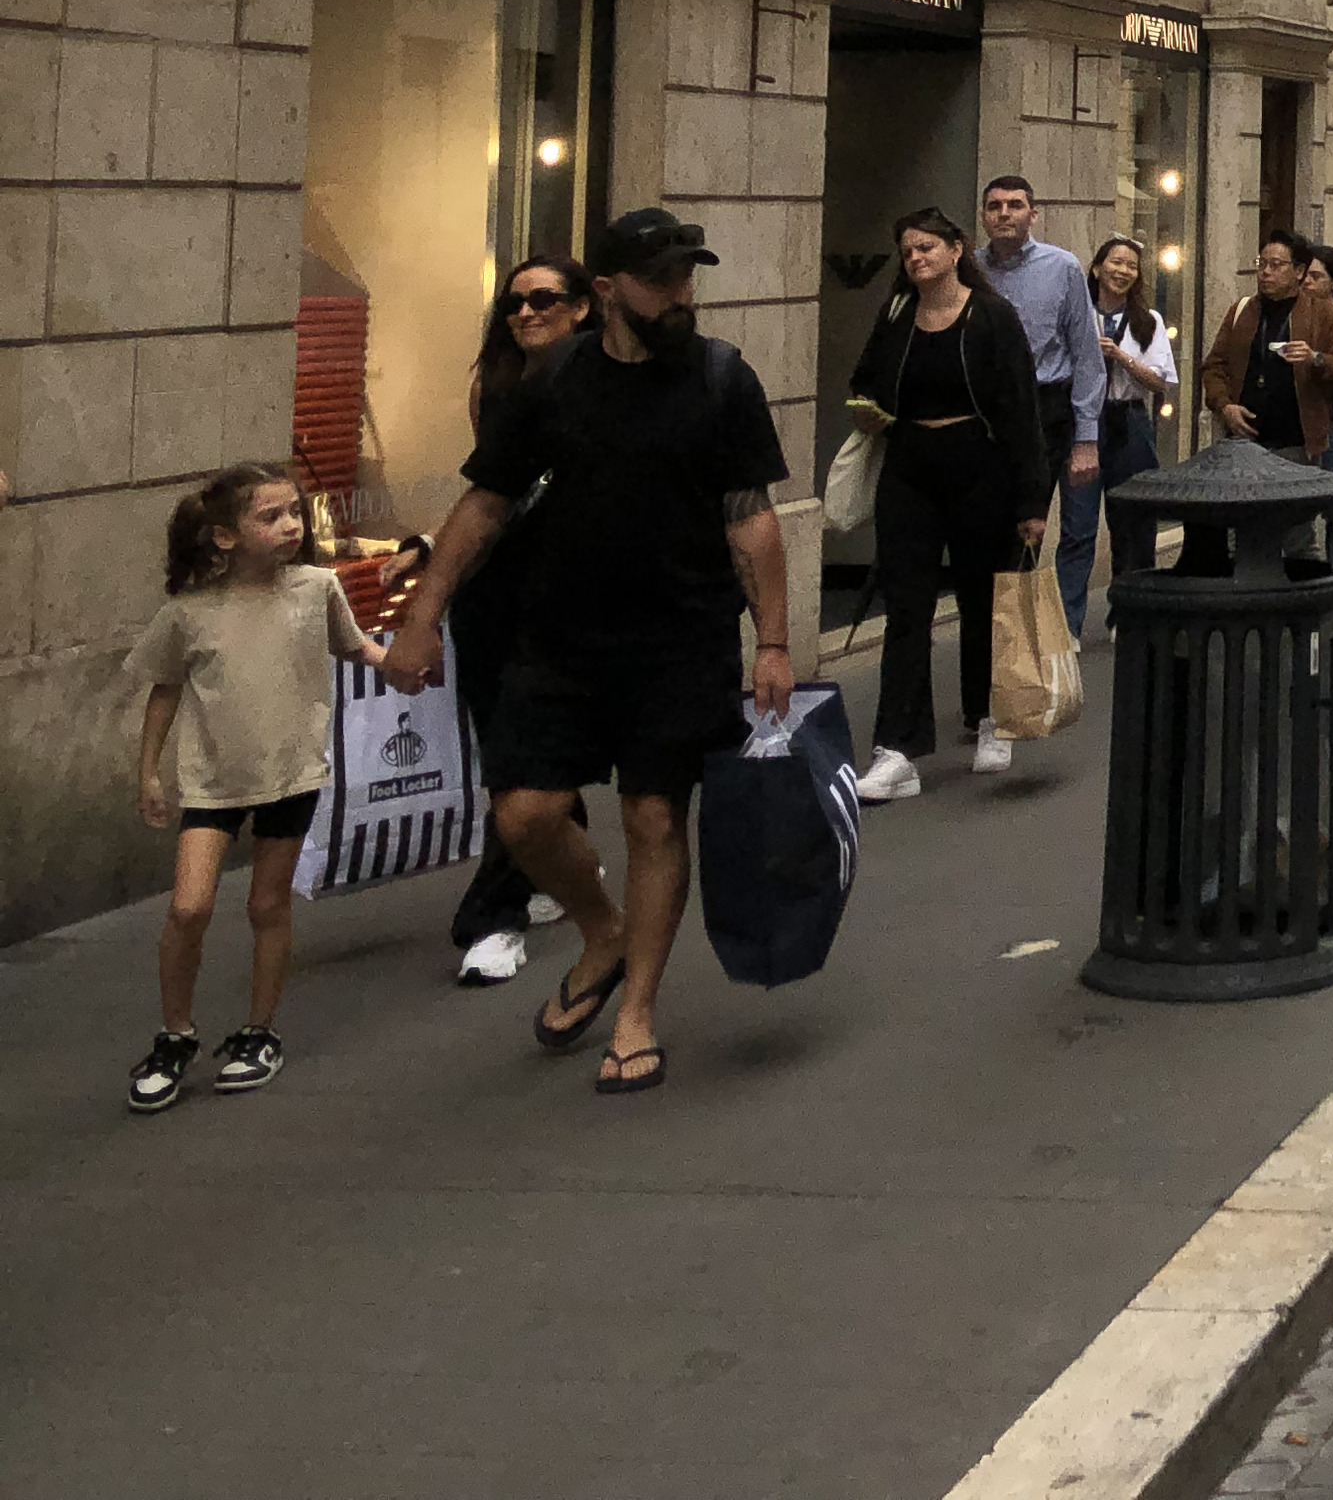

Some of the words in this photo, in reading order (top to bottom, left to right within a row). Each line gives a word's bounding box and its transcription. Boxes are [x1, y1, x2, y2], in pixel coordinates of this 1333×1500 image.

[1160, 18, 1198, 54] ARMANI
[371, 781, 398, 799] Foot
[401, 775, 441, 794] Locker
